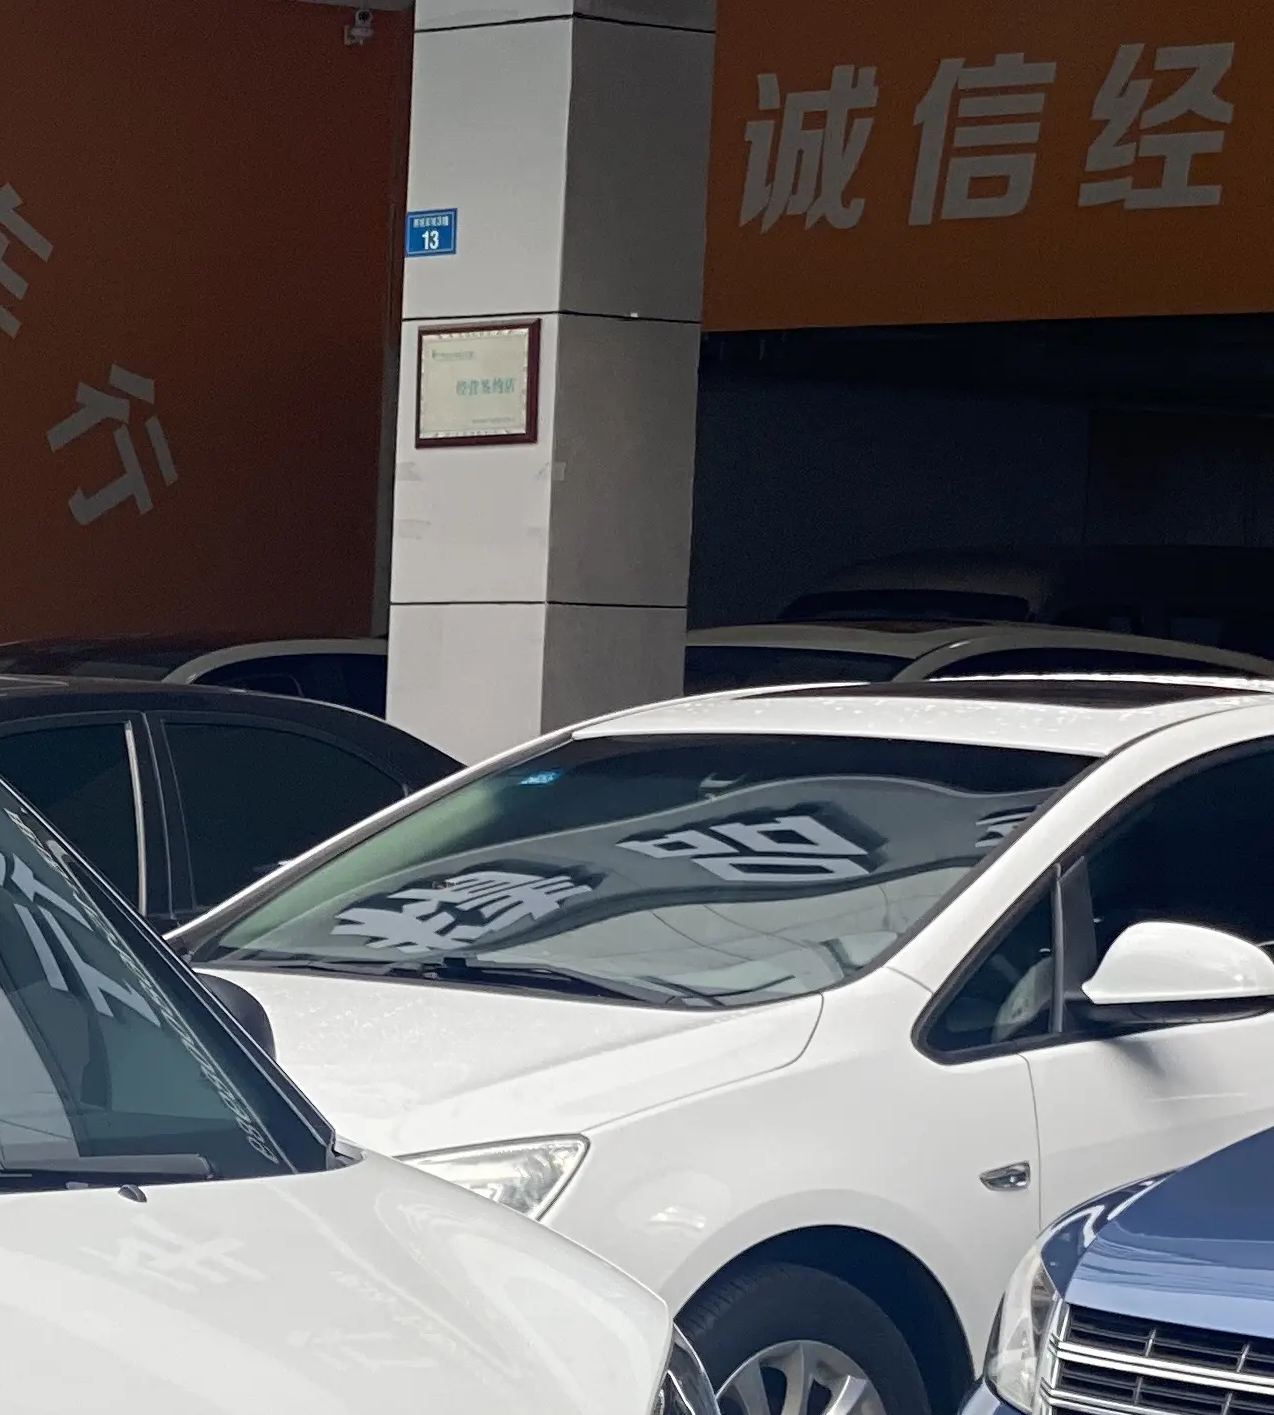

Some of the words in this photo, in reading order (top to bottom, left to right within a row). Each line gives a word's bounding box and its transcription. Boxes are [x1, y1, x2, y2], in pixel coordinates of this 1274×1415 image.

[739, 41, 1236, 233] 诚信经
[422, 230, 440, 250] 13
